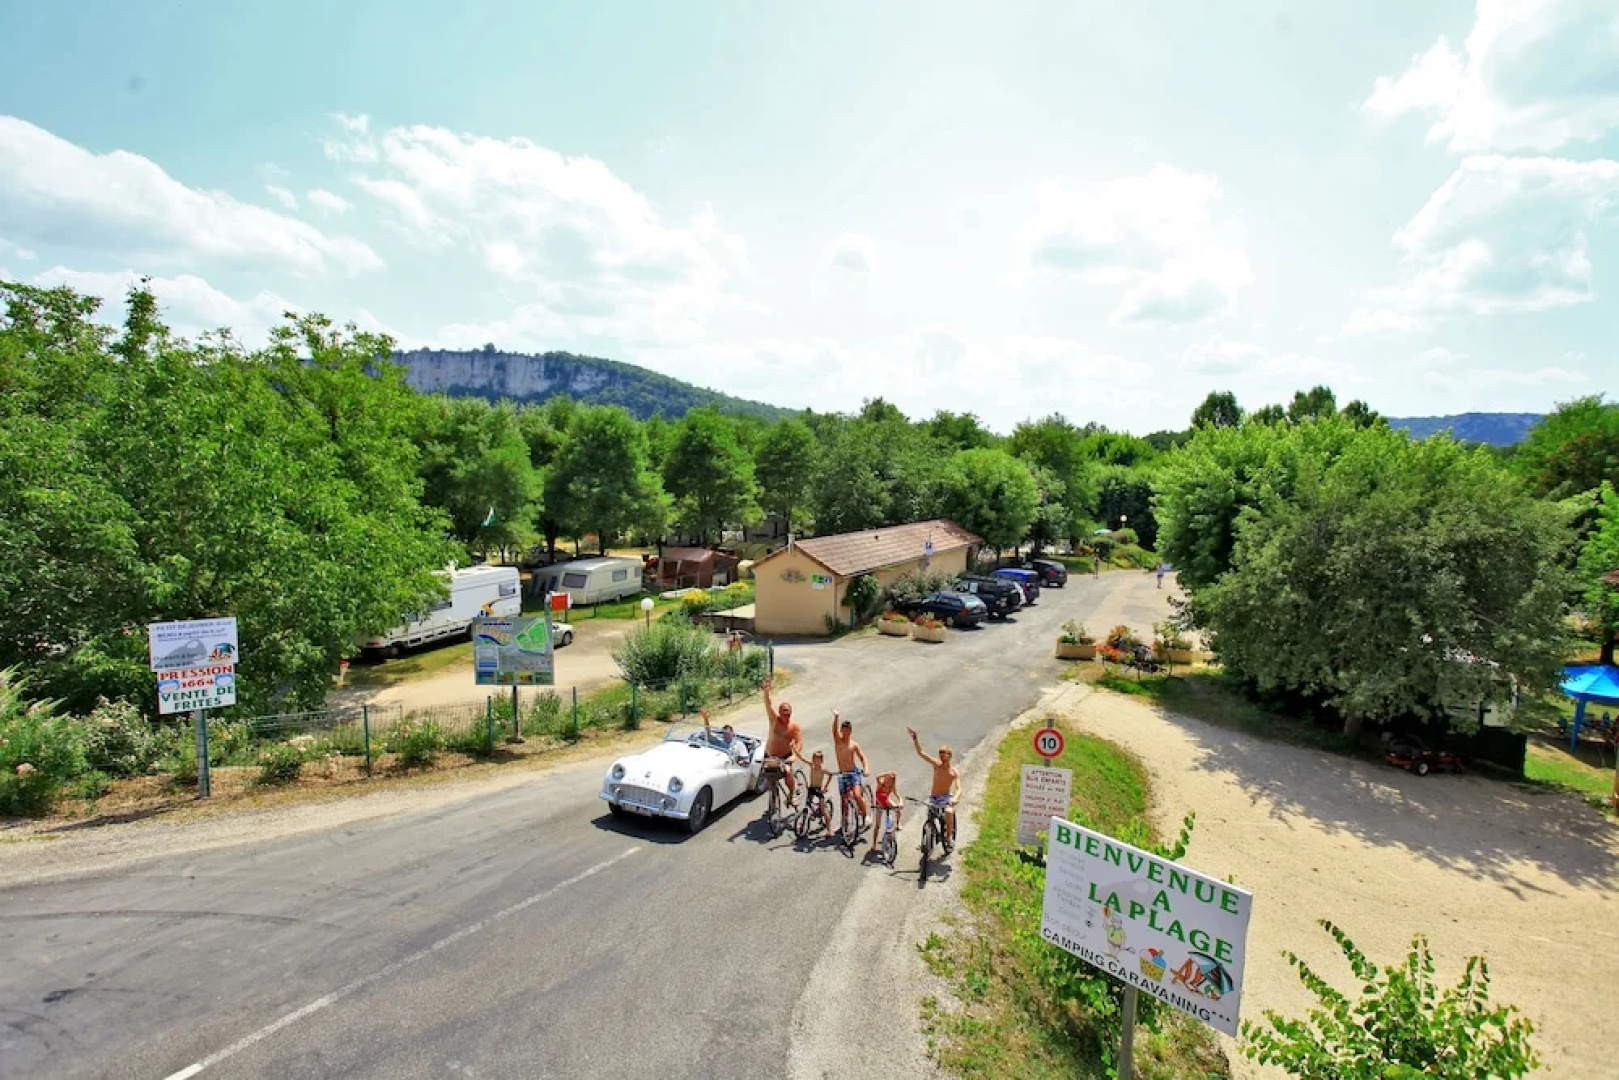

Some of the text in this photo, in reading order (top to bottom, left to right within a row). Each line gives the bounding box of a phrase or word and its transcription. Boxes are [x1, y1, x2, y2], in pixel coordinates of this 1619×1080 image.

[160, 665, 232, 680] PRESSION
[181, 678, 215, 688] 1664
[162, 686, 233, 702] VENTE DE
[174, 697, 222, 710] FRITES
[1041, 737, 1057, 750] 10
[1056, 824, 1240, 915] BIENVENUE
[1152, 889, 1172, 913] A
[1087, 882, 1122, 914] LA
[1128, 900, 1234, 964] PLAGE
[1043, 927, 1105, 966] CAMPING
